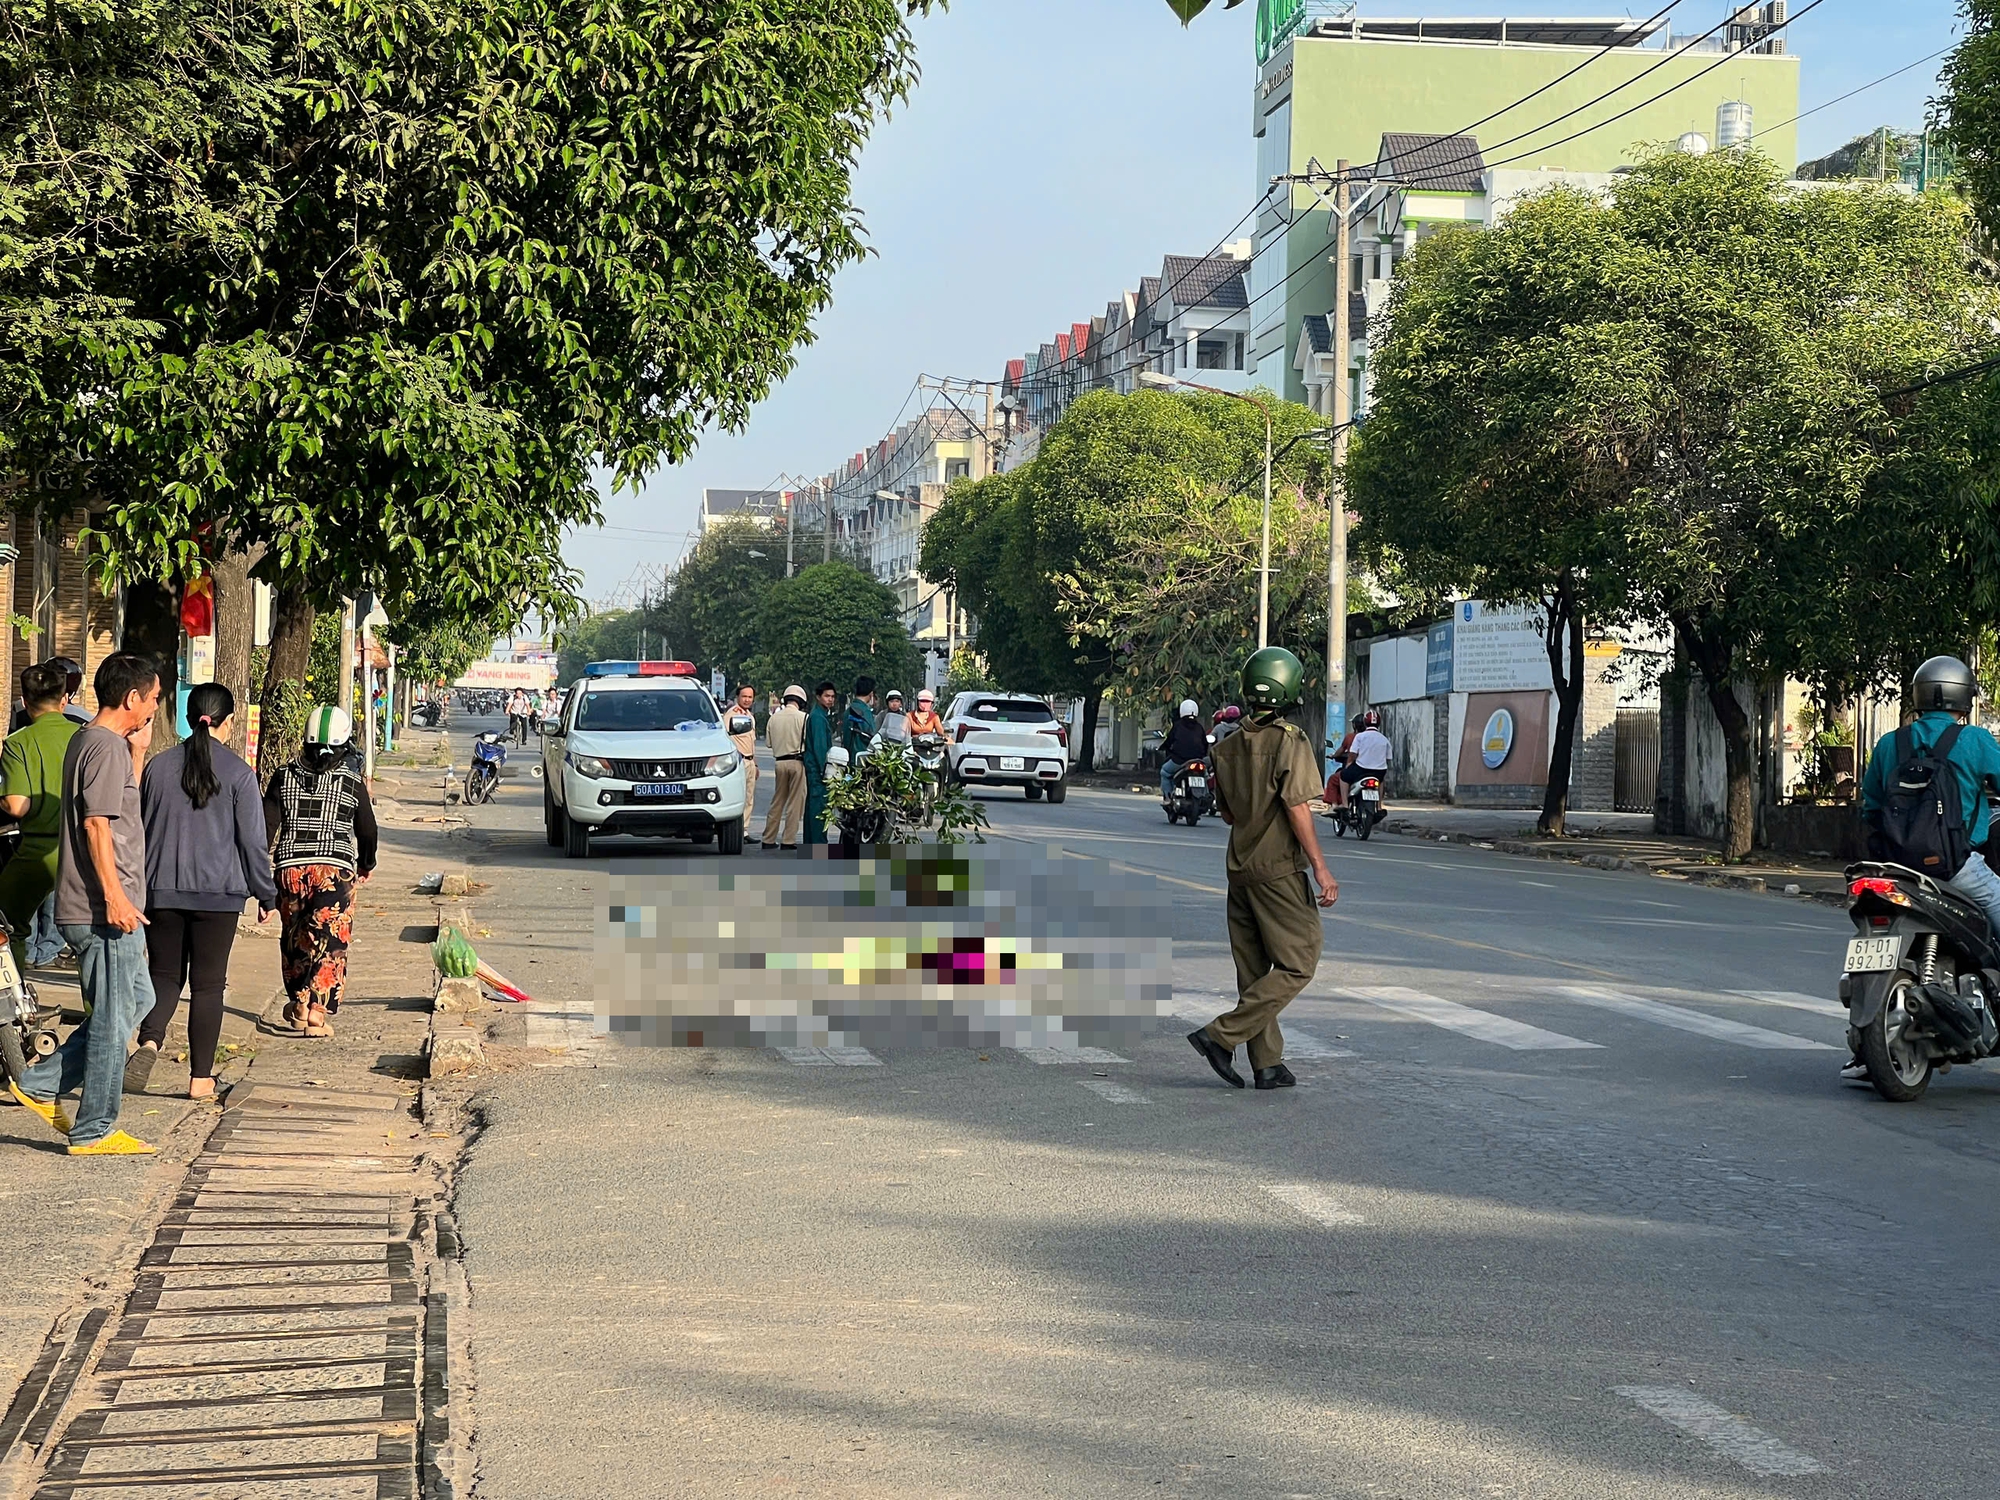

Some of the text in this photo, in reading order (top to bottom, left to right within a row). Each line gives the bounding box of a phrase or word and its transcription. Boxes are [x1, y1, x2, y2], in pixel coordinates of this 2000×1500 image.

[477, 670, 531, 680] YANG MING
[1855, 939, 1891, 954] 61-D1
[1847, 954, 1894, 970] 992.13
